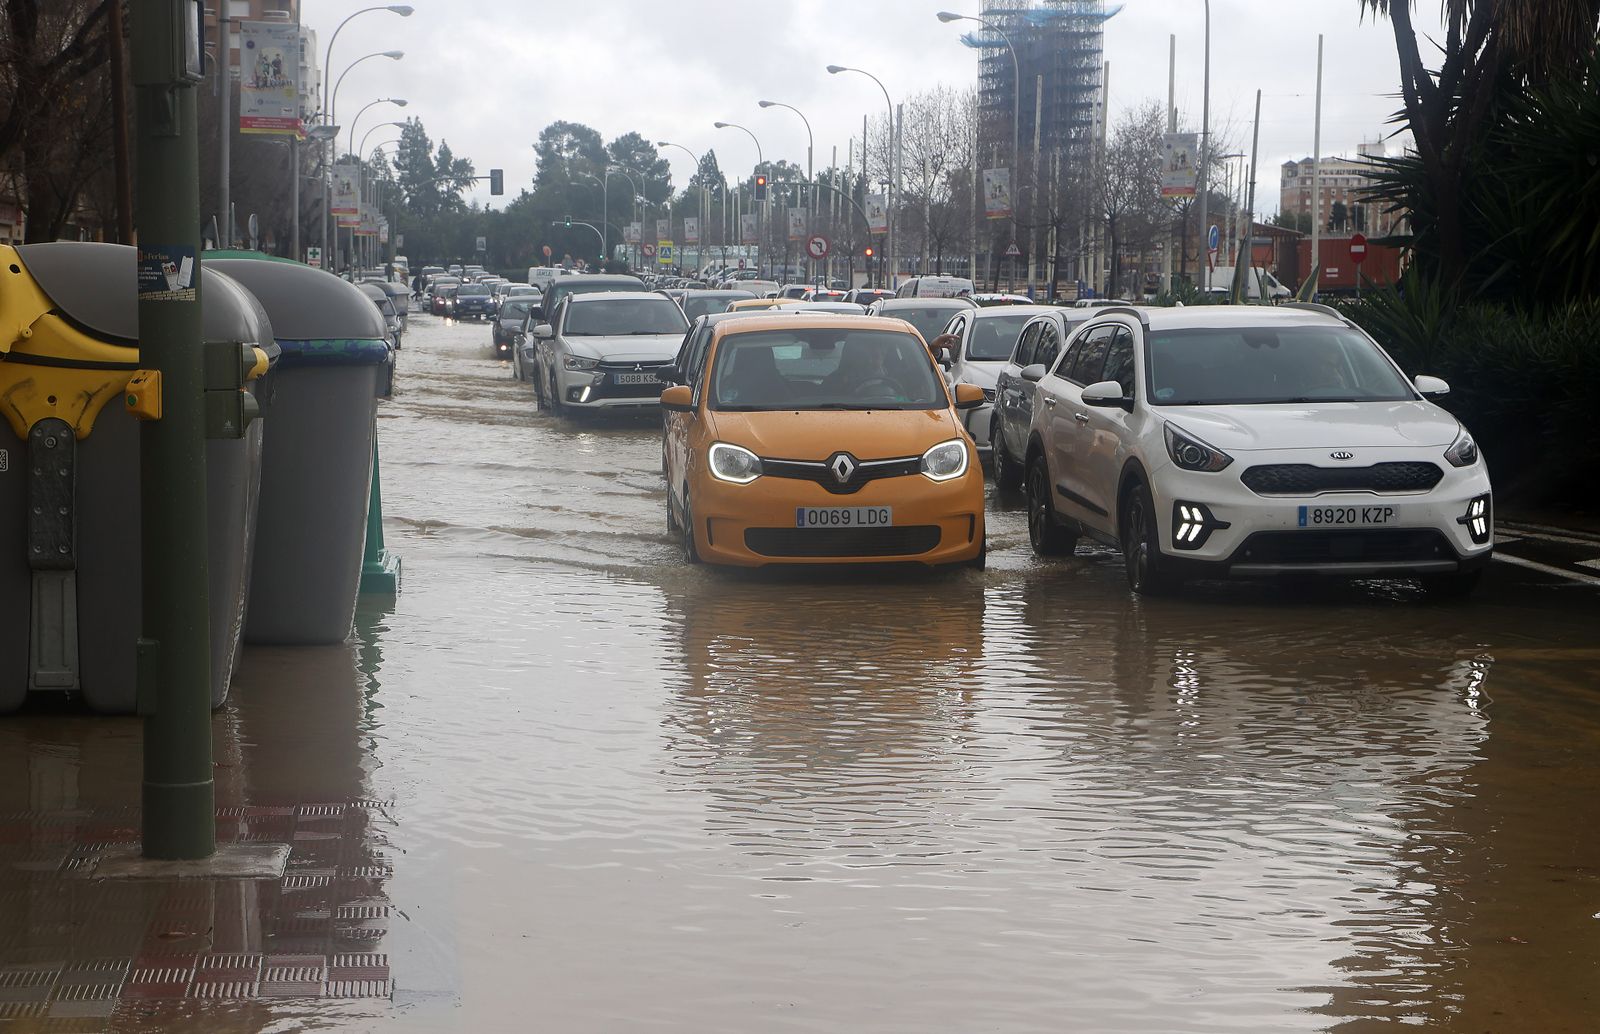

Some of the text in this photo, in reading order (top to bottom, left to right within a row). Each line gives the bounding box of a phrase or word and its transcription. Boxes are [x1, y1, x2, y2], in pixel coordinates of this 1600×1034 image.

[620, 375, 642, 383] 5088
[808, 509, 888, 525] 0069 LDG
[1313, 507, 1393, 524] 8920 KZP
